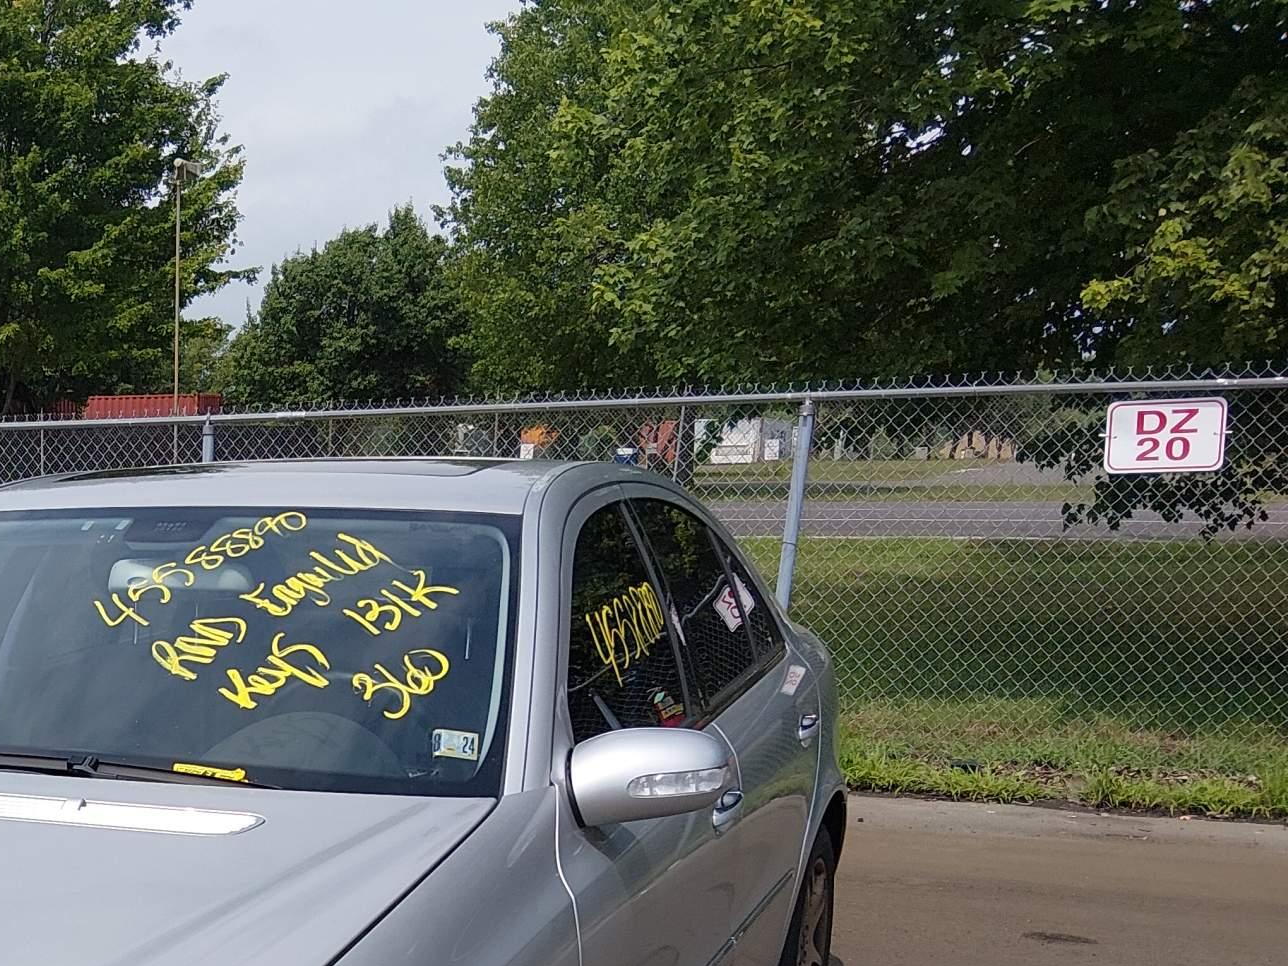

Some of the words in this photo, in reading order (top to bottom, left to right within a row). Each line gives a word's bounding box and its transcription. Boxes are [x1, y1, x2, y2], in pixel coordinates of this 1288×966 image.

[1136, 408, 1199, 435] DZ
[1136, 436, 1190, 461] 20
[342, 570, 460, 635] 131K
[462, 736, 475, 755] 24
